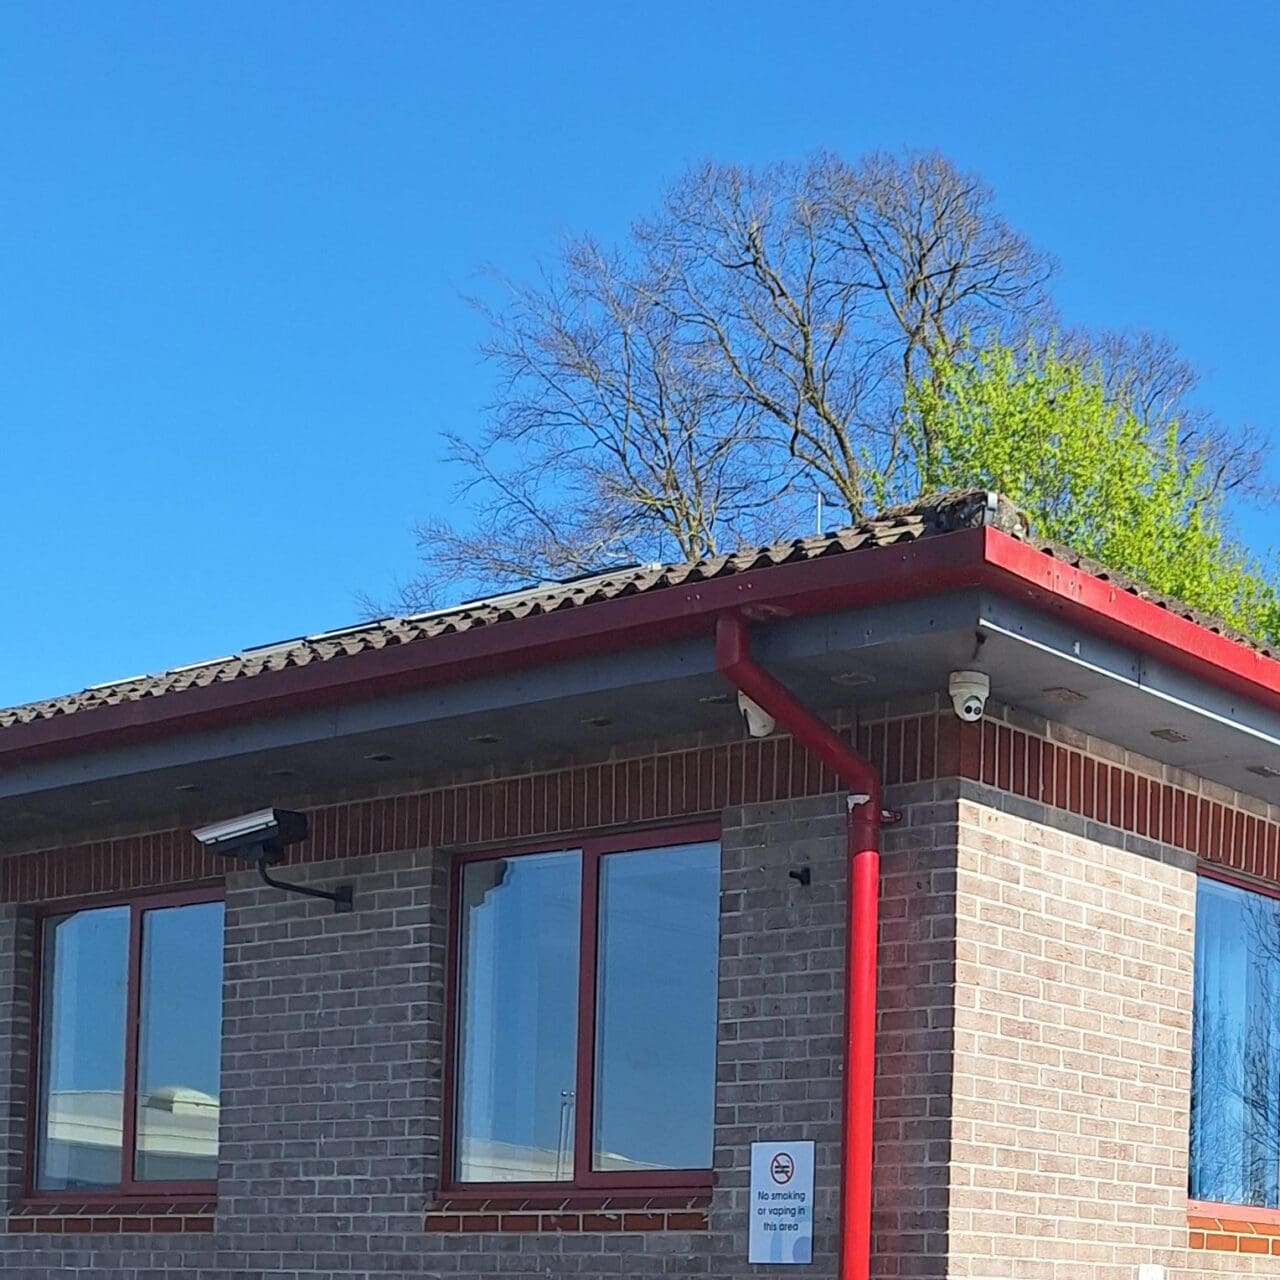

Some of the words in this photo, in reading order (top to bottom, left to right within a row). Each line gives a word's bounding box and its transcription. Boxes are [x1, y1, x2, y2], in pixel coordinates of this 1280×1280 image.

[758, 1191, 769, 1200] No
[771, 1191, 806, 1202] smoking
[757, 1207, 766, 1215] or
[769, 1206, 796, 1217] vaping
[797, 1206, 806, 1215] in
[764, 1221, 777, 1231] this
[779, 1223, 798, 1231] area
